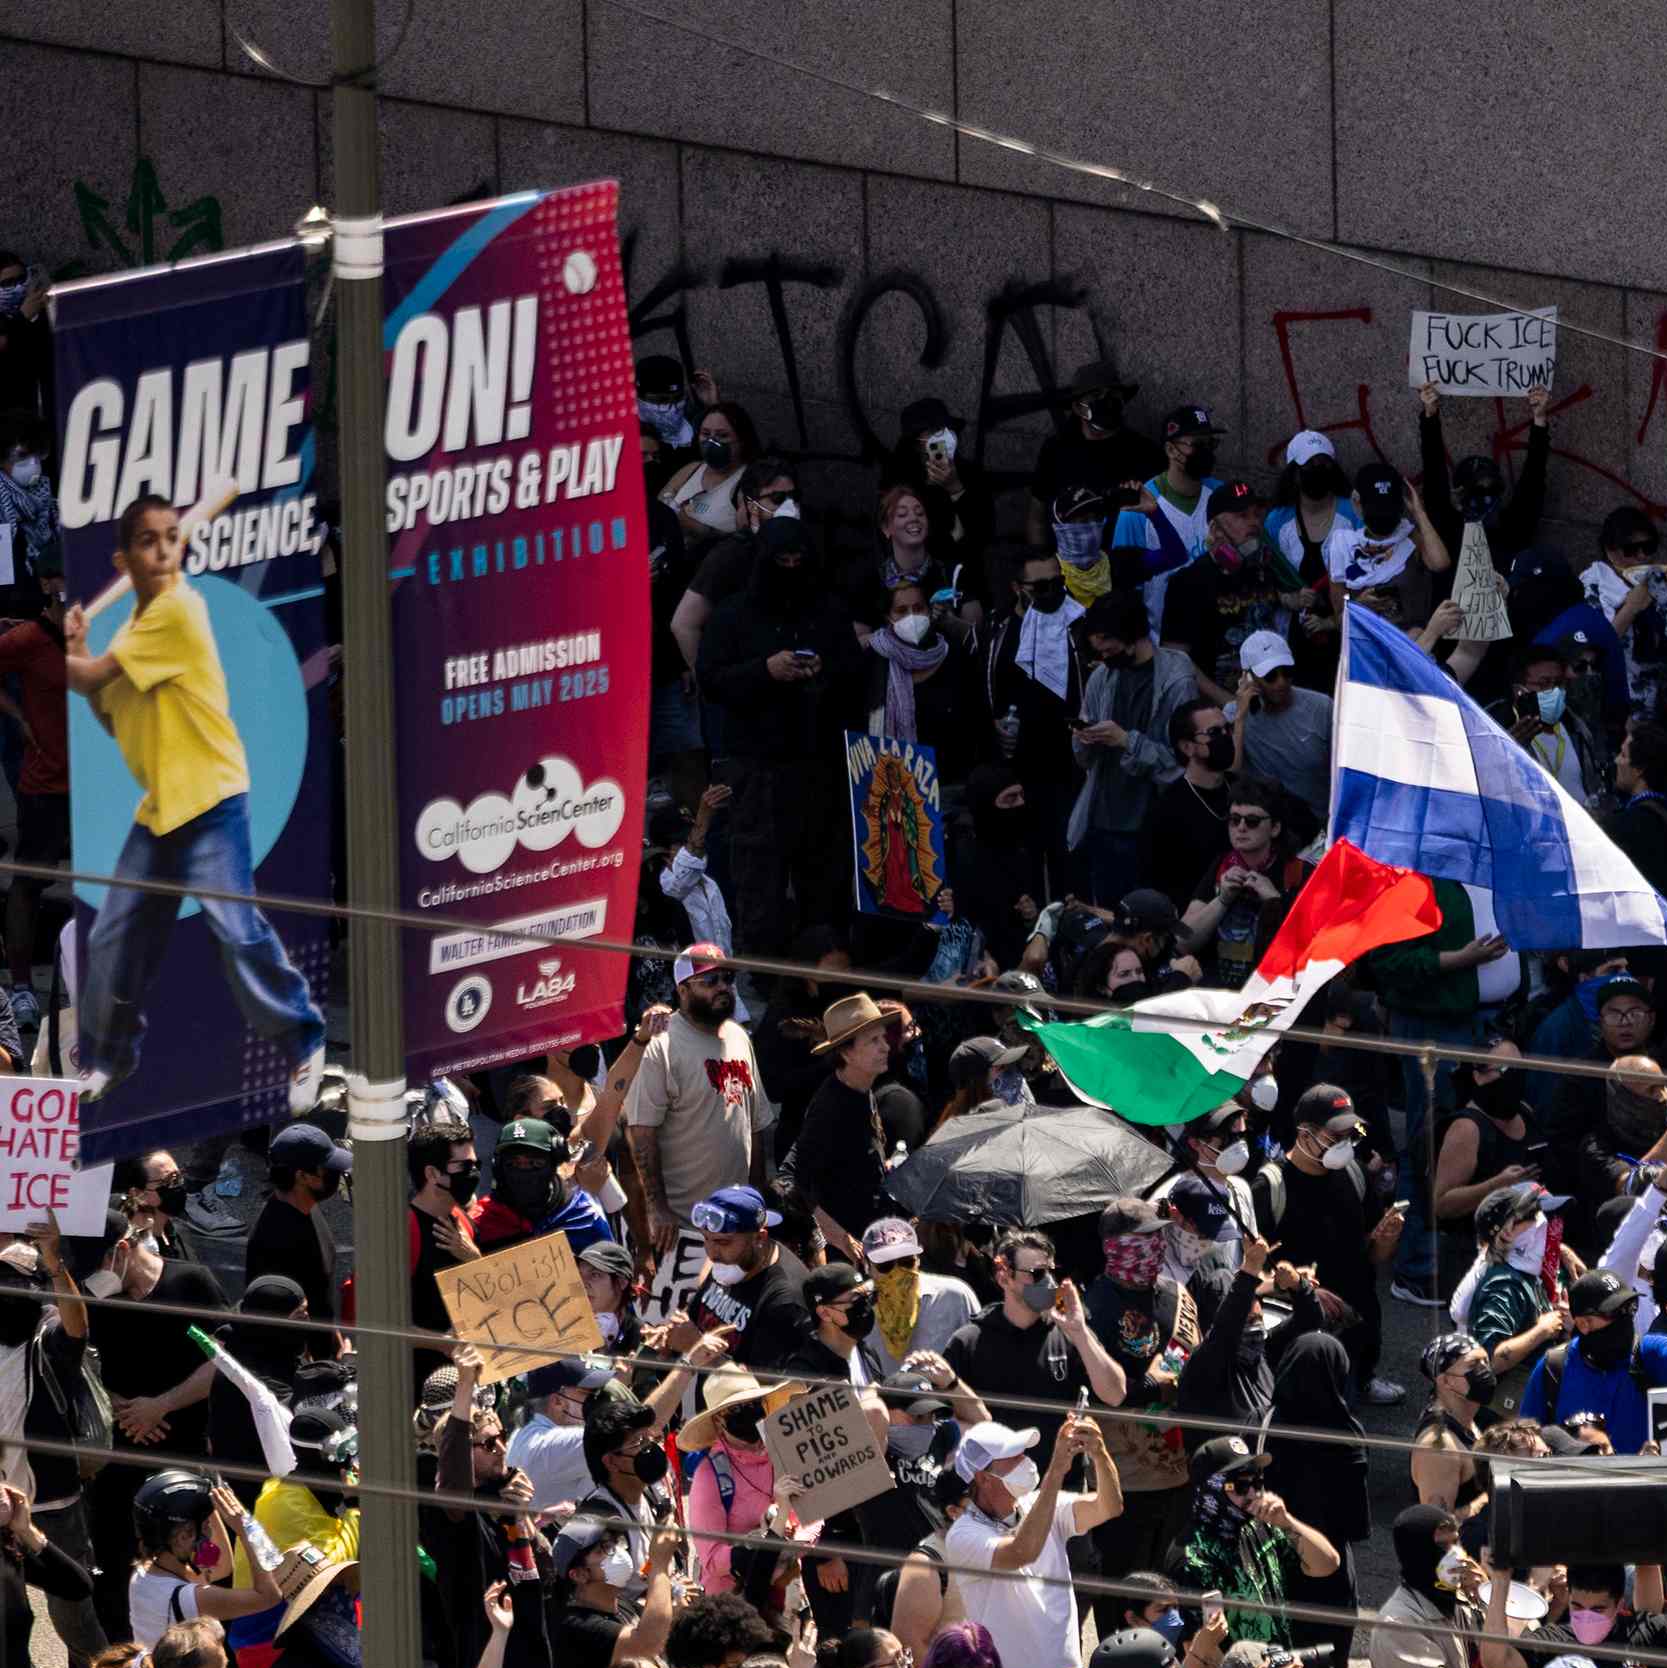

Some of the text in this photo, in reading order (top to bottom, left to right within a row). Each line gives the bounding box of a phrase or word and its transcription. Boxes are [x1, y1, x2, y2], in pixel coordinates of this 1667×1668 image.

[1426, 313, 1555, 352] FUCK ICE
[383, 296, 541, 463] ON!
[1422, 355, 1558, 391] FUCK TRUMP
[57, 341, 313, 529] GAME
[386, 433, 626, 534] SPORTS & PLAY
[186, 496, 325, 577] SCIENCE,
[430, 516, 630, 587] EXHIBITION
[444, 630, 603, 691] FREE ADMISSION
[441, 665, 611, 728] OPENS MAY 2025
[849, 737, 878, 785] VIVA
[7, 1171, 72, 1213] ICE
[476, 1282, 588, 1346] ICE
[777, 1388, 852, 1438] SHAME
[807, 1423, 824, 1438] TO
[795, 1425, 851, 1464] PIGS
[800, 1445, 877, 1490] COWARDS
